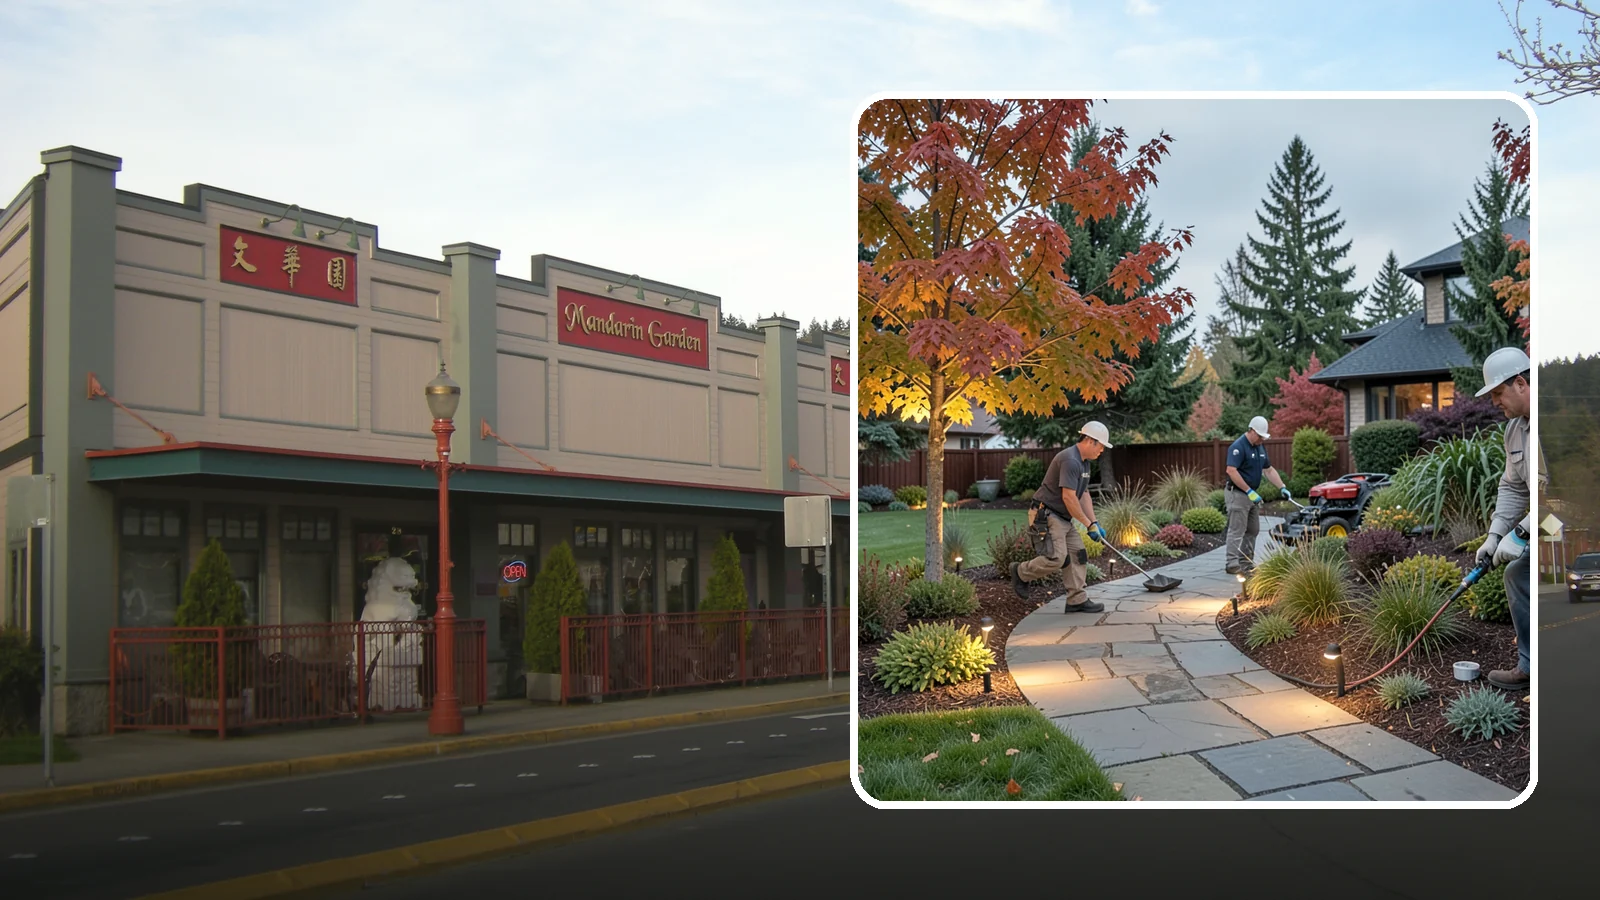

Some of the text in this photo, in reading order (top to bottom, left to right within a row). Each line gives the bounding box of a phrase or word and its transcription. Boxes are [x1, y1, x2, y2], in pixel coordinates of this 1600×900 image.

[231, 236, 346, 291] 文華園
[565, 302, 701, 352] Mandarin Garden
[503, 565, 527, 578] OPEN
